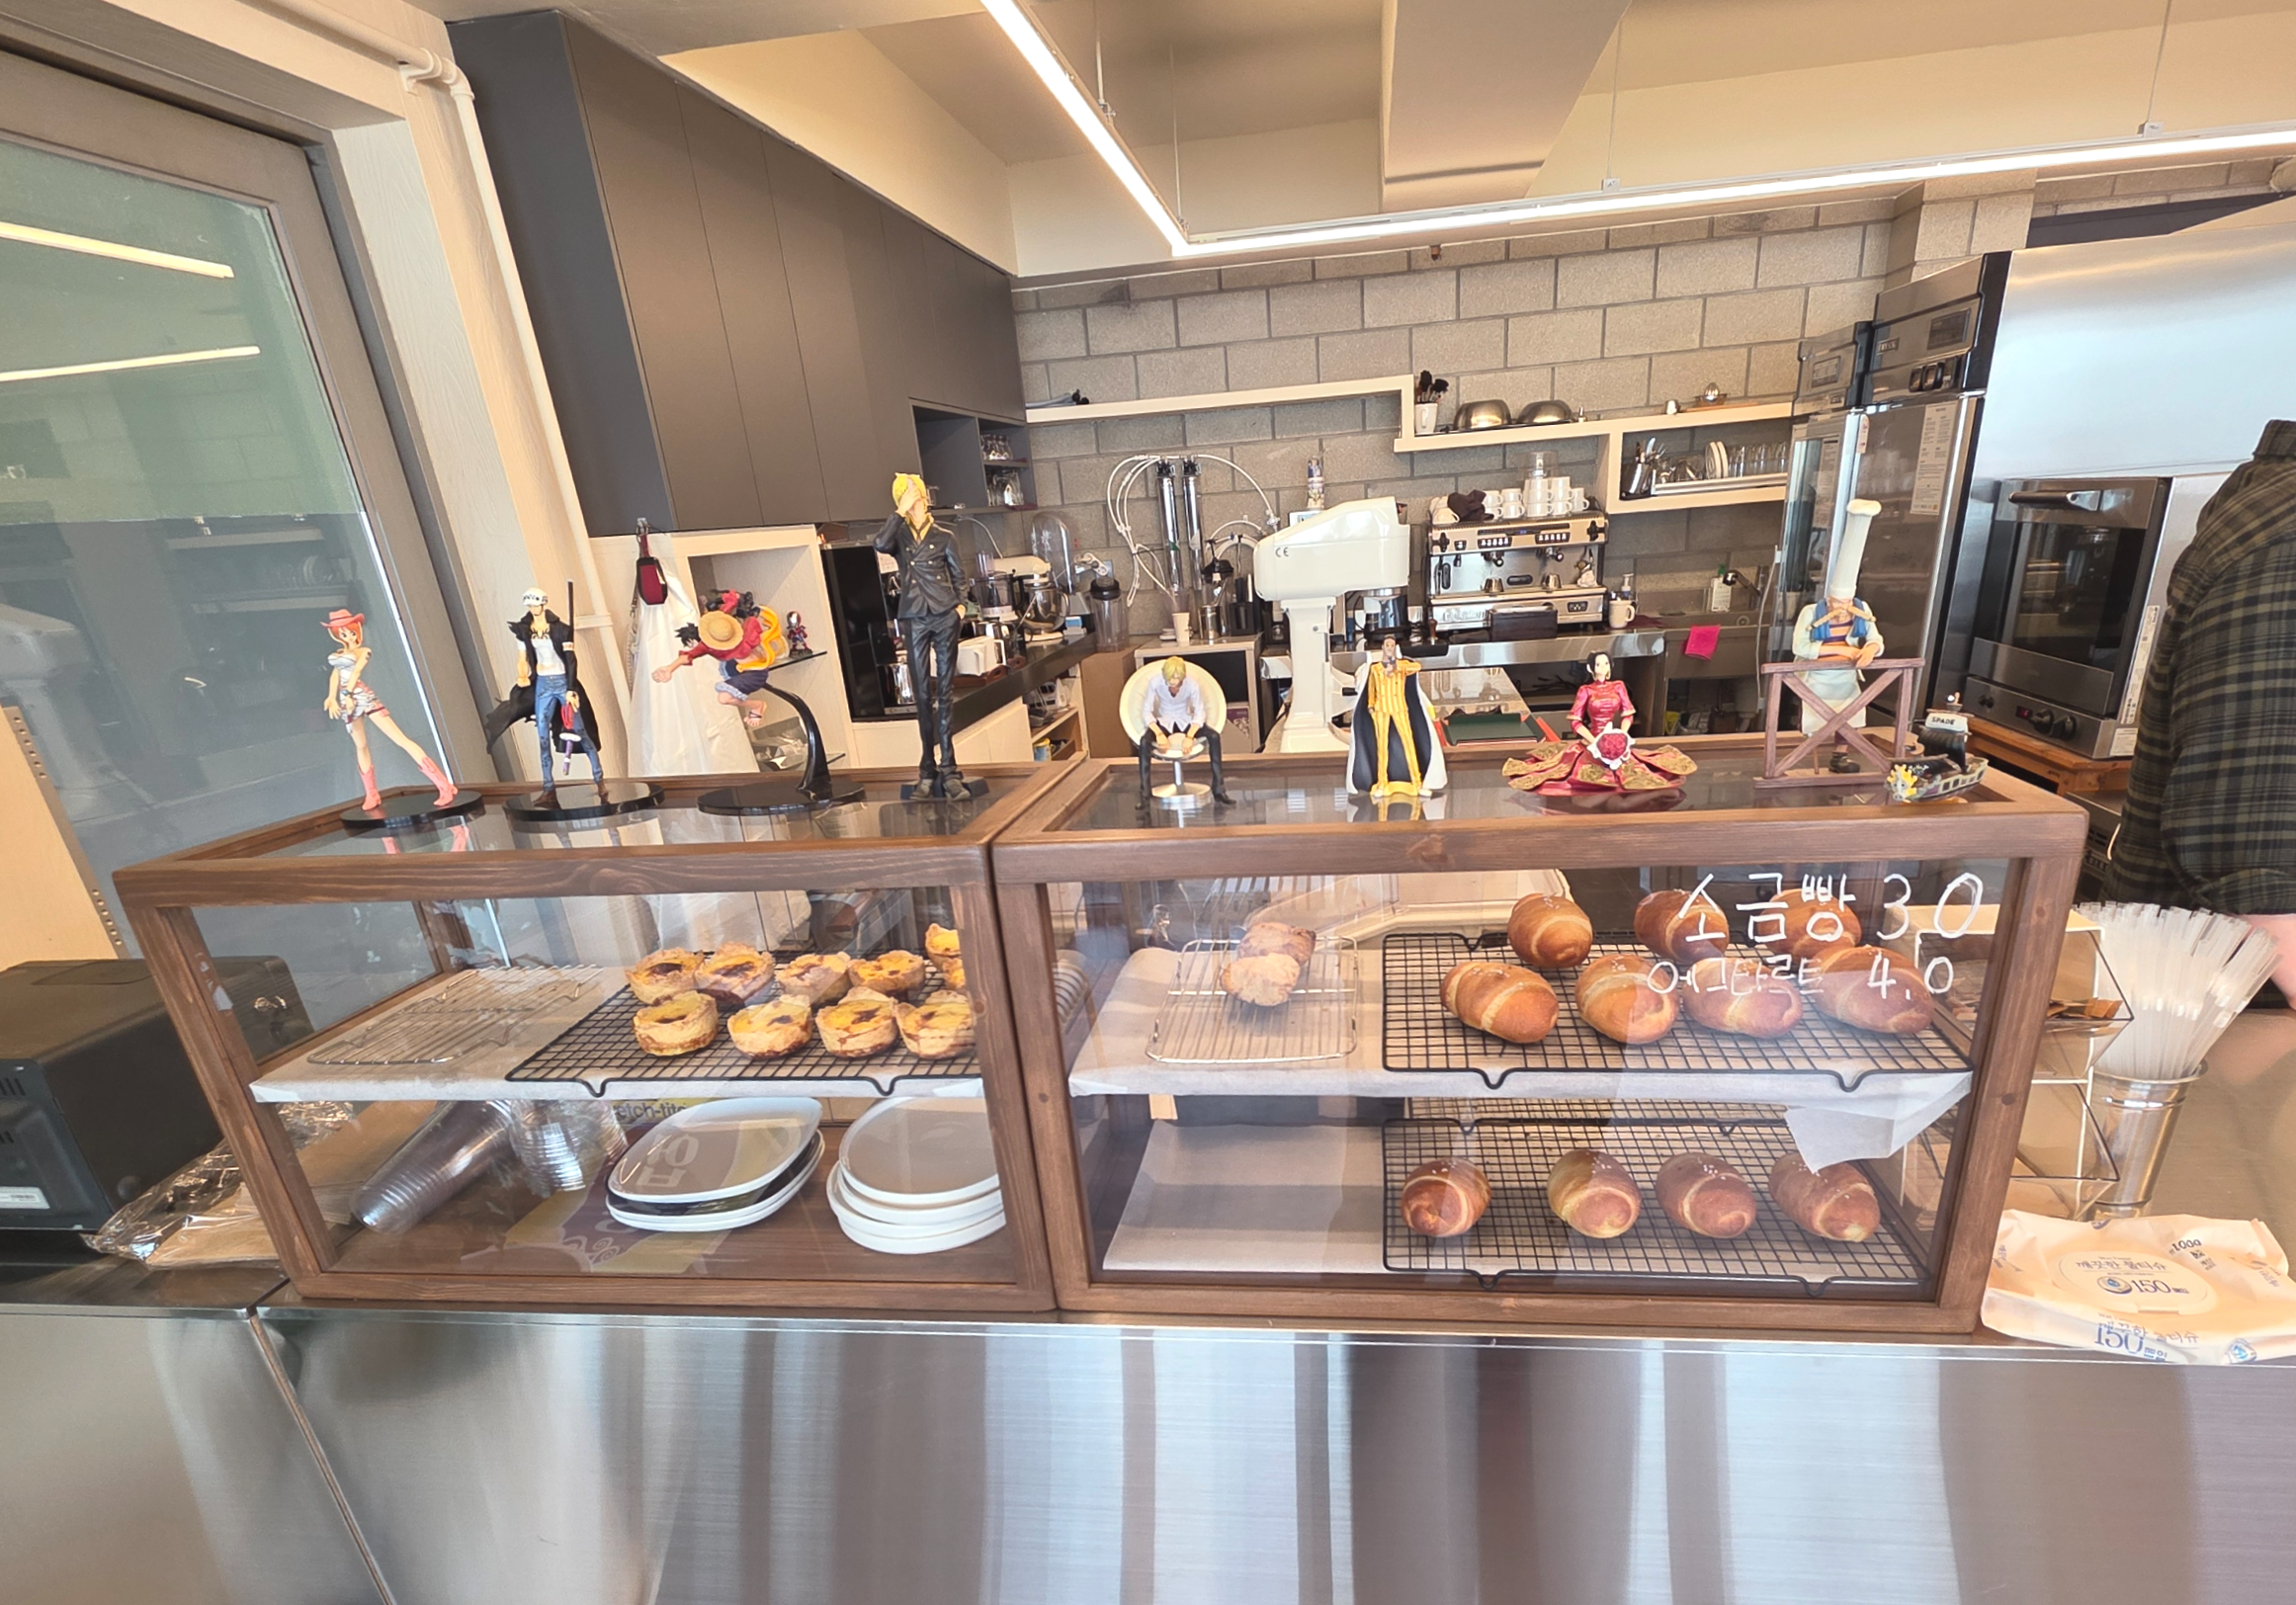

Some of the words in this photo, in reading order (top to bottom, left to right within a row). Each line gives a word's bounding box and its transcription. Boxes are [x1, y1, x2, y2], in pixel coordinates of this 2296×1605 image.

[1931, 717, 1956, 725] SPADE
[1679, 873, 1857, 943] 소금빵
[1647, 954, 1826, 996] 에그타르트
[1867, 950, 1954, 1001] 4.0
[2131, 1279, 2171, 1294] 150
[2094, 1324, 2144, 1354] 150
